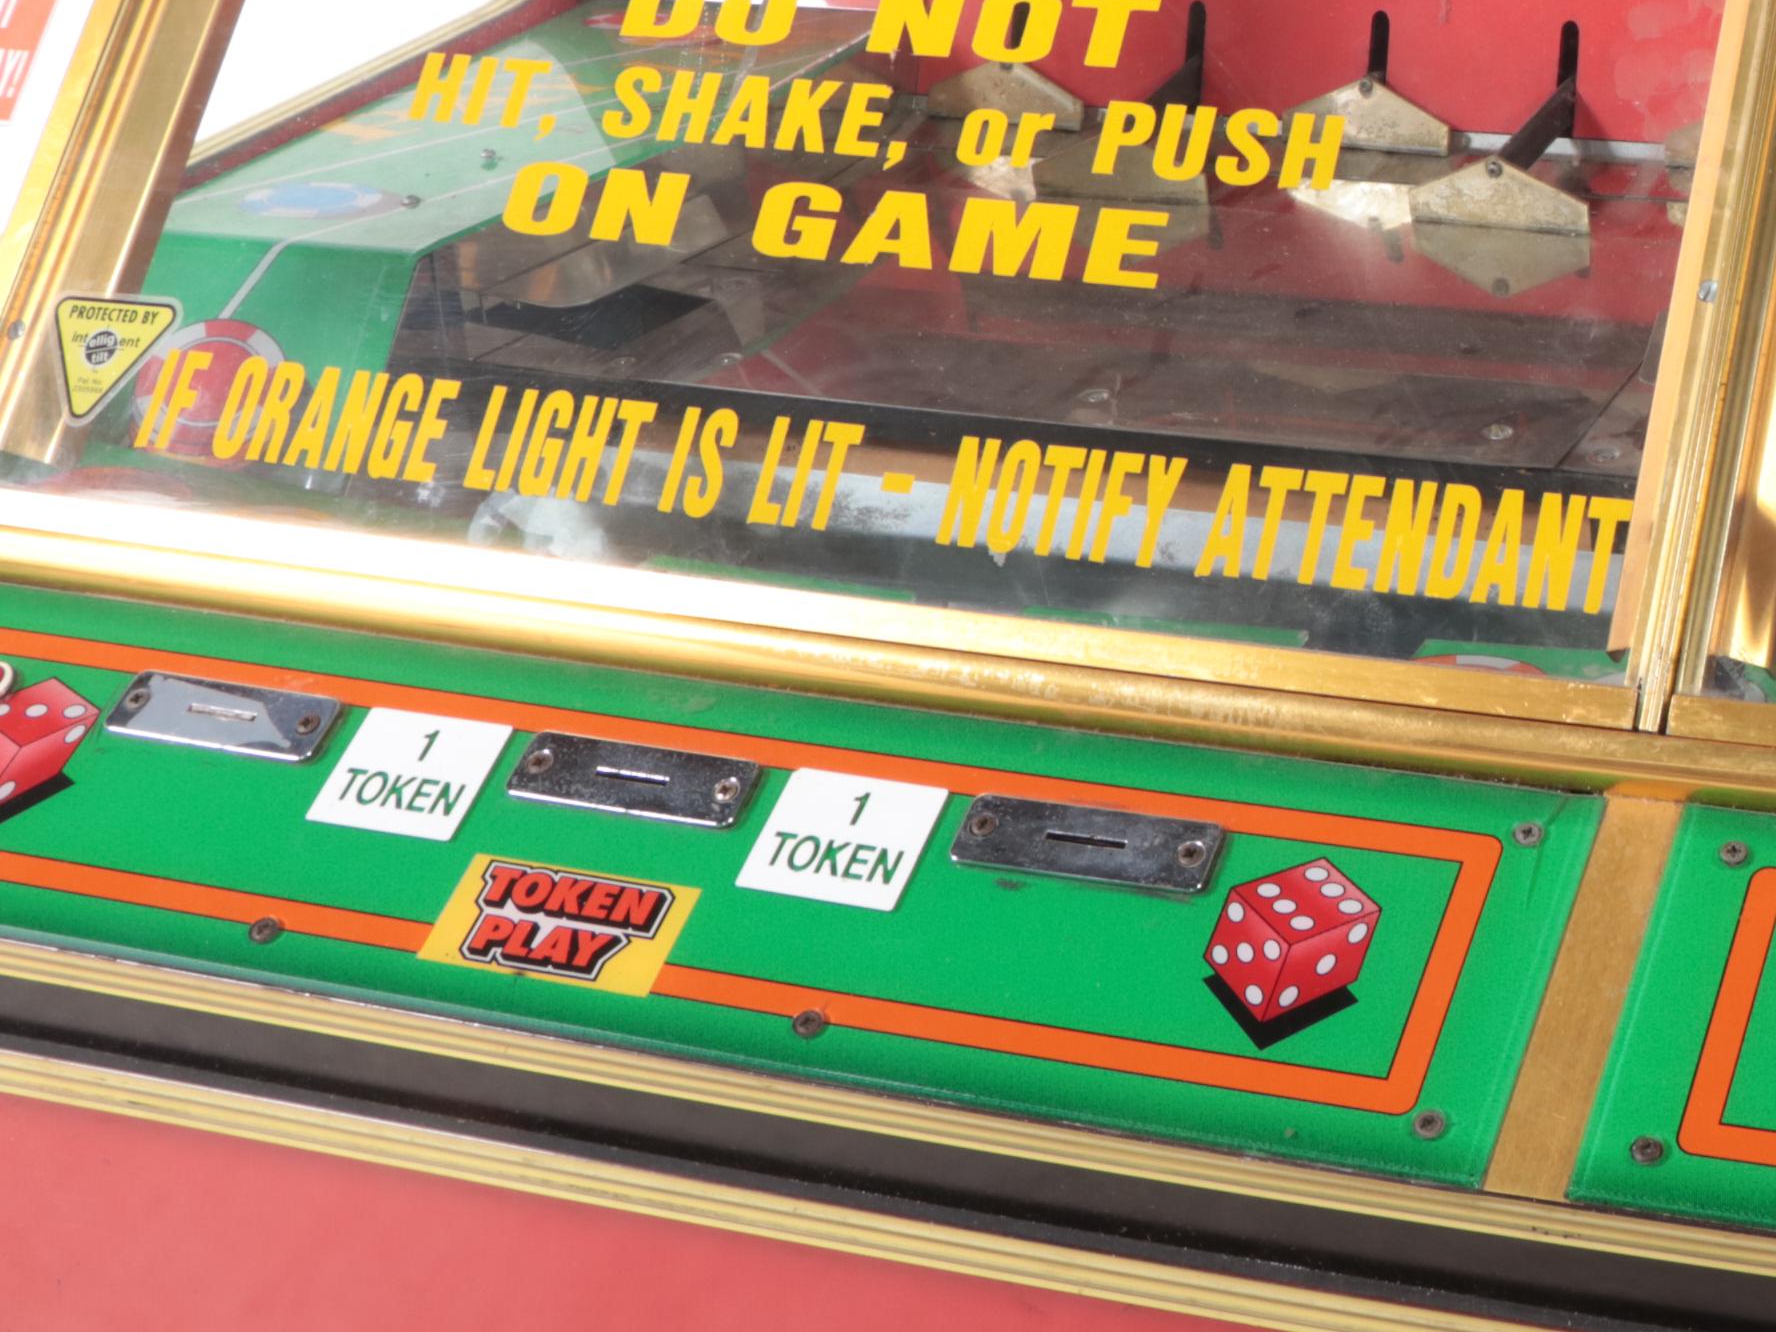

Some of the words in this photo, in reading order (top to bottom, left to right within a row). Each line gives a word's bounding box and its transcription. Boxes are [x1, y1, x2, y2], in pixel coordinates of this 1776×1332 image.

[409, 51, 556, 136] HIT,
[601, 63, 909, 170] SHAKE,
[955, 106, 1058, 170] or
[1091, 99, 1347, 192] PUSH
[502, 161, 691, 247] ON
[750, 180, 1171, 290] GAME
[69, 304, 138, 323] PROTECTED
[141, 310, 160, 325] BY
[91, 352, 109, 365] tilt
[134, 348, 215, 448] IF
[212, 356, 461, 483] ORANGE
[464, 385, 659, 506] LIGHT
[657, 406, 741, 519] IS
[746, 415, 866, 531] LIT
[936, 435, 1189, 567] NOTIFY
[1196, 464, 1634, 616] ATTENDANT
[417, 729, 441, 762] 1
[338, 767, 467, 818] TOKEN
[849, 792, 871, 826] 1
[768, 831, 905, 885] TOKEN
[484, 865, 663, 930] TOKEN
[468, 913, 618, 970] PLAY
